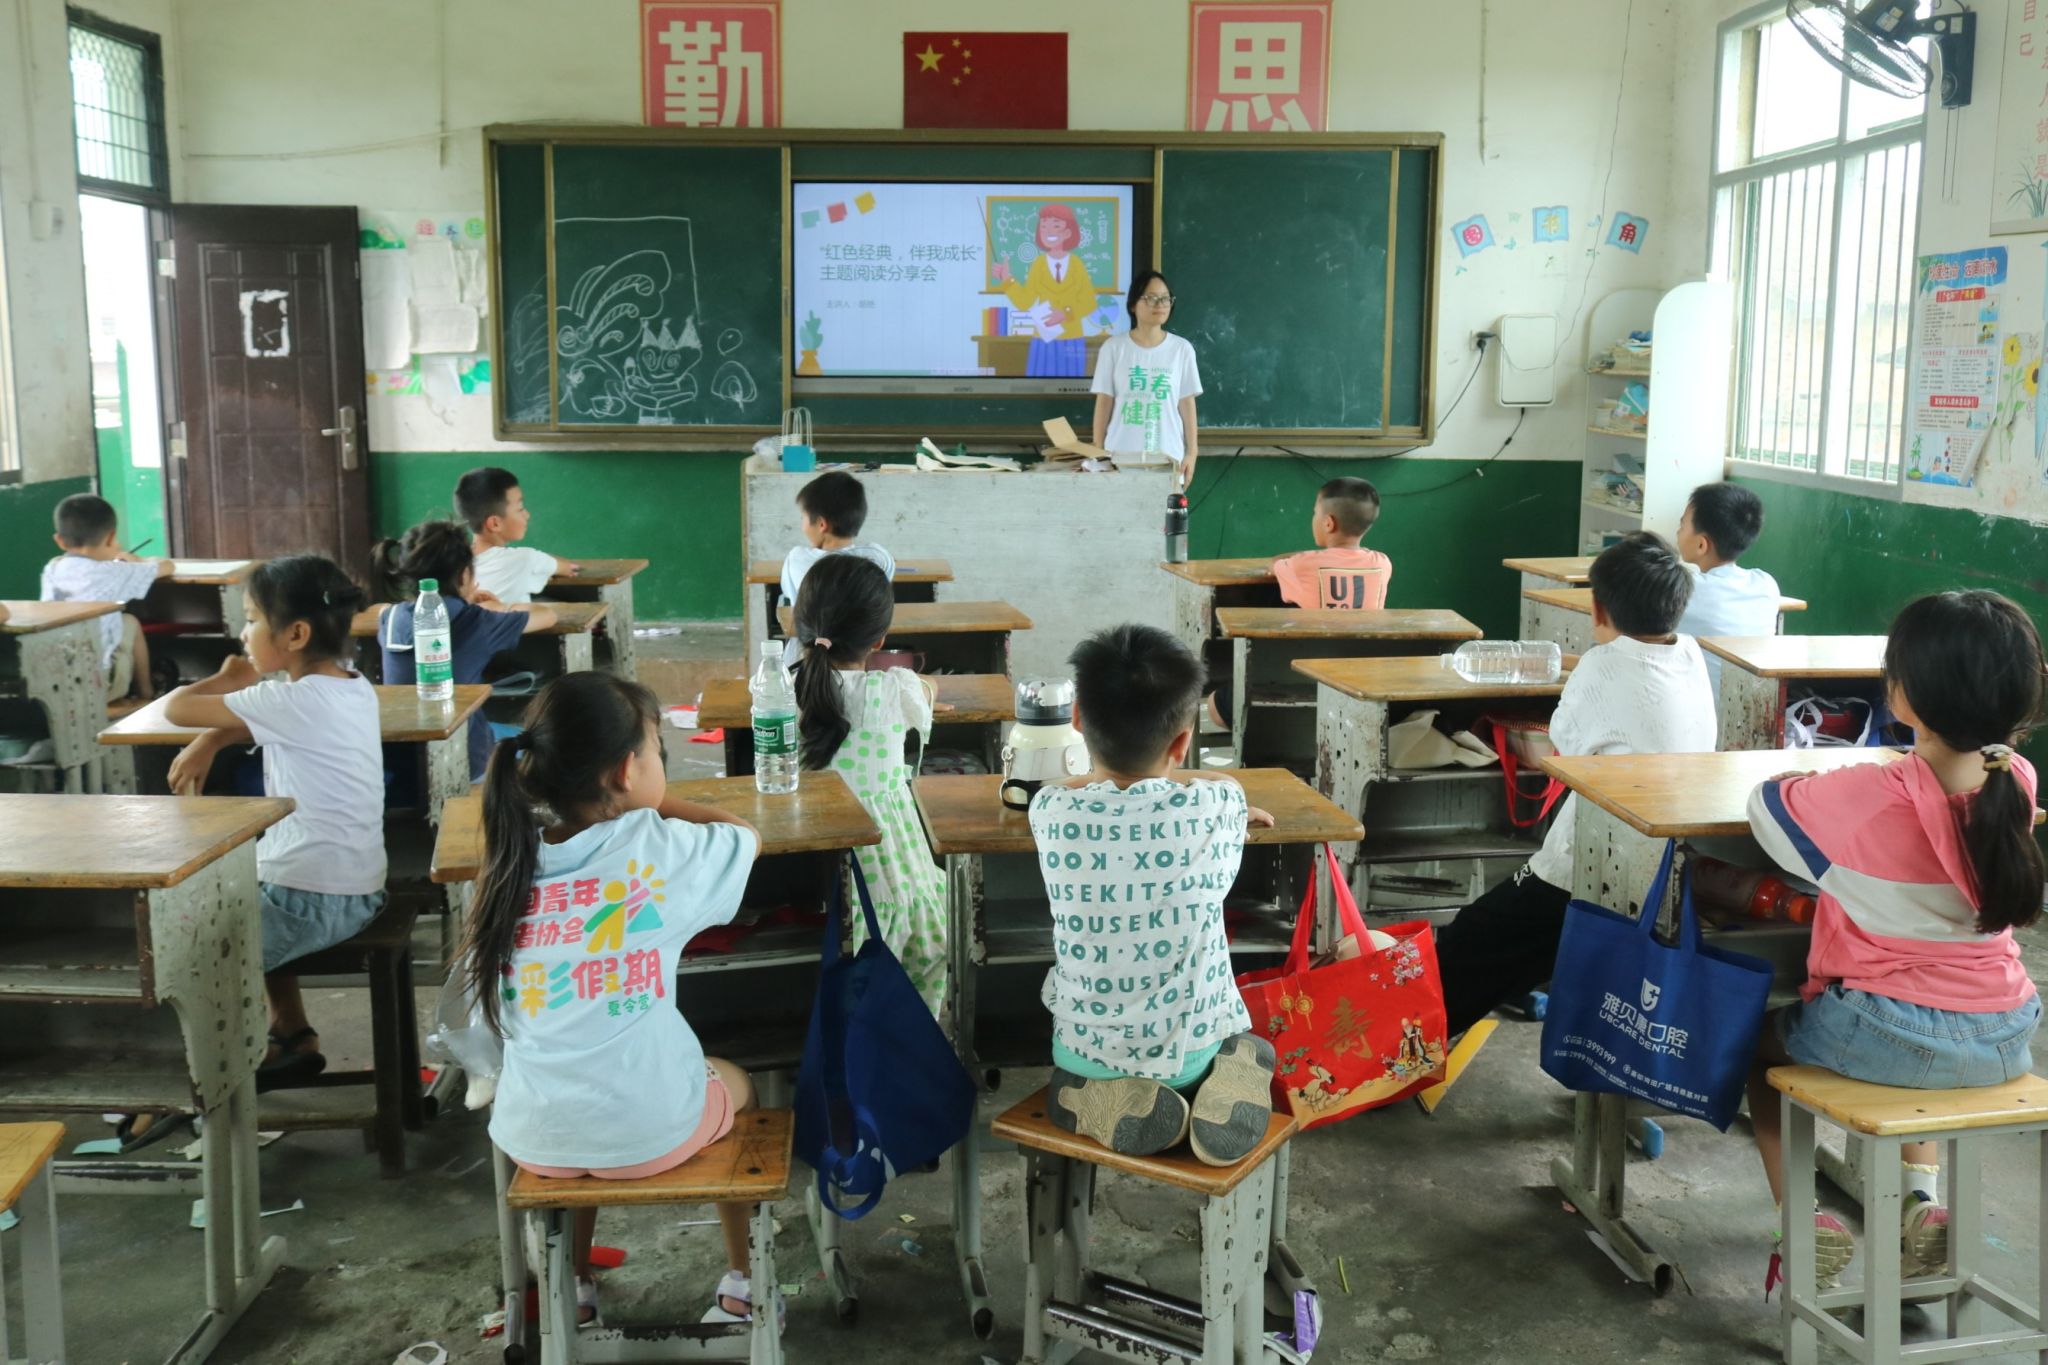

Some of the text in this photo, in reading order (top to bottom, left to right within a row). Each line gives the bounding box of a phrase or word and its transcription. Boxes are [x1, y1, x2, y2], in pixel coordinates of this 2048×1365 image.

[658, 21, 763, 127] 勤
[1204, 22, 1312, 132] 思
[820, 265, 937, 282] 主题阅读分享会
[1127, 365, 1172, 400] 青春
[1121, 399, 1162, 425] 健康
[1067, 797, 1125, 816] FOX
[1151, 790, 1199, 812] FOX
[1134, 849, 1190, 870] FOX
[607, 993, 650, 1017] 夏令营
[1144, 980, 1195, 1012] FOX
[1072, 998, 1124, 1018] FOX
[1127, 1041, 1178, 1061] FOX
[1586, 1039, 1617, 1065] 3993999
[1638, 1037, 1685, 1060] DENTAL
